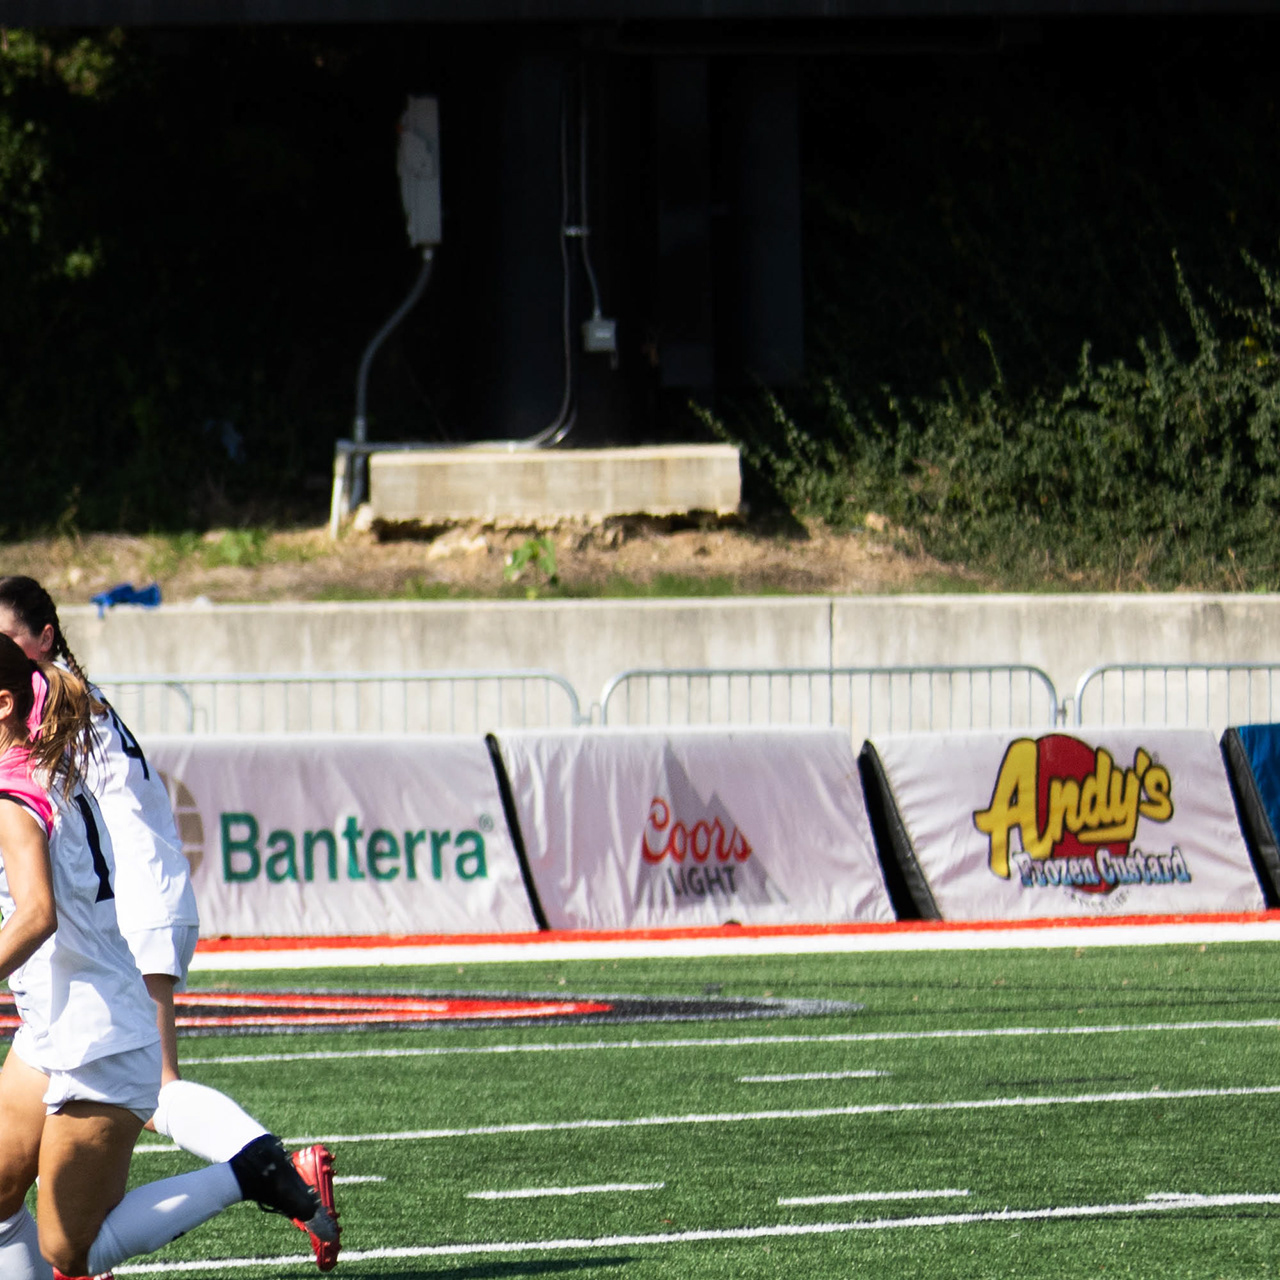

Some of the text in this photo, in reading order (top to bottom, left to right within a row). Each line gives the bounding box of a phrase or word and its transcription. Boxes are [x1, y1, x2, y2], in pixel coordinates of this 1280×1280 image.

[642, 796, 752, 864] Coors
[973, 737, 1174, 880] Andy's
[219, 812, 488, 884] Banterra
[667, 866, 738, 896] LIGHT
[1012, 845, 1192, 887] Frozen Custard
